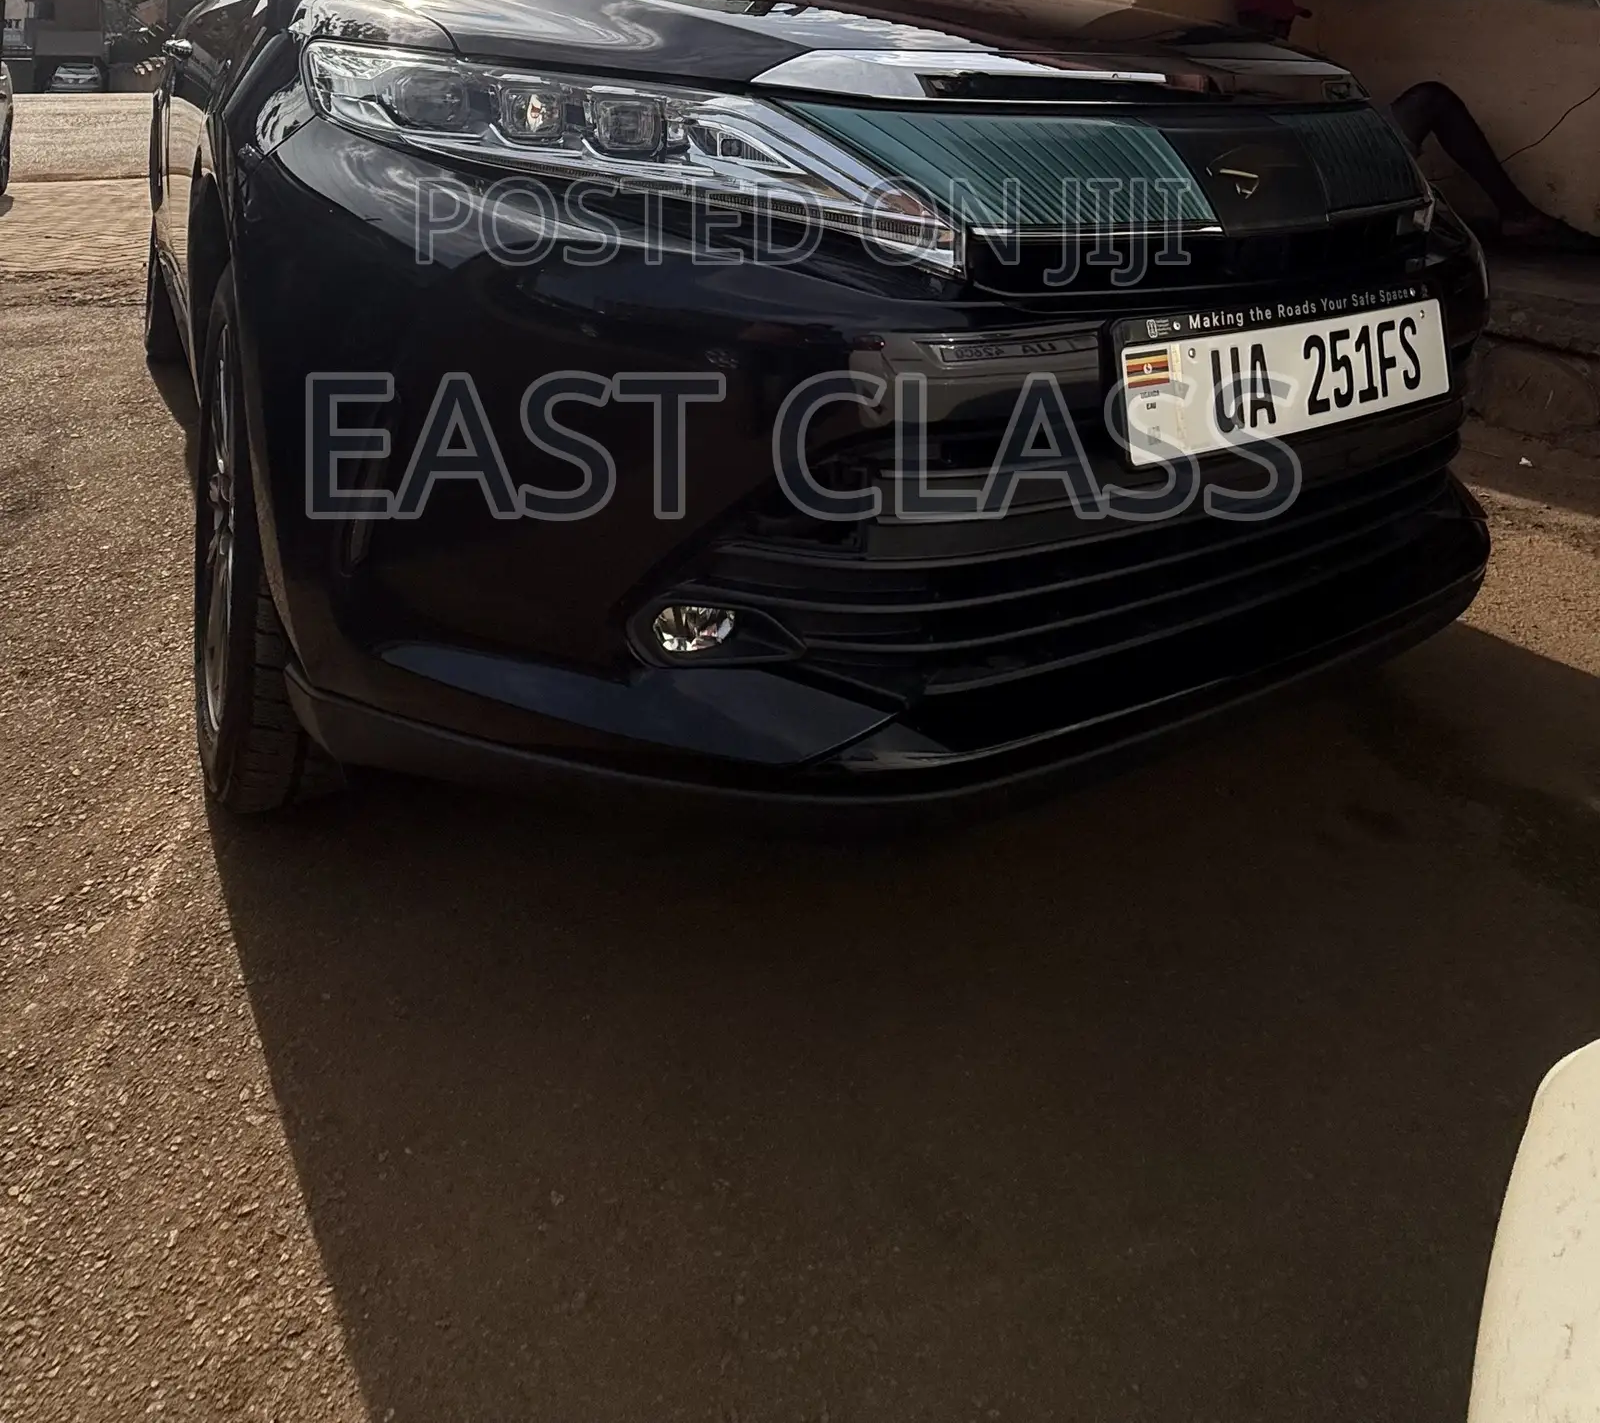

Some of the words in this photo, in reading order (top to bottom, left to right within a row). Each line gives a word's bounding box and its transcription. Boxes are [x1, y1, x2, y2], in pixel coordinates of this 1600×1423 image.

[1189, 309, 1244, 330] Making
[1250, 306, 1272, 321] the
[1278, 300, 1317, 318] Roads
[1321, 292, 1347, 310] Your
[1351, 293, 1376, 308] Safe
[1380, 287, 1409, 305] Space
[1210, 344, 1277, 434] UA
[1303, 317, 1422, 416] 251FS
